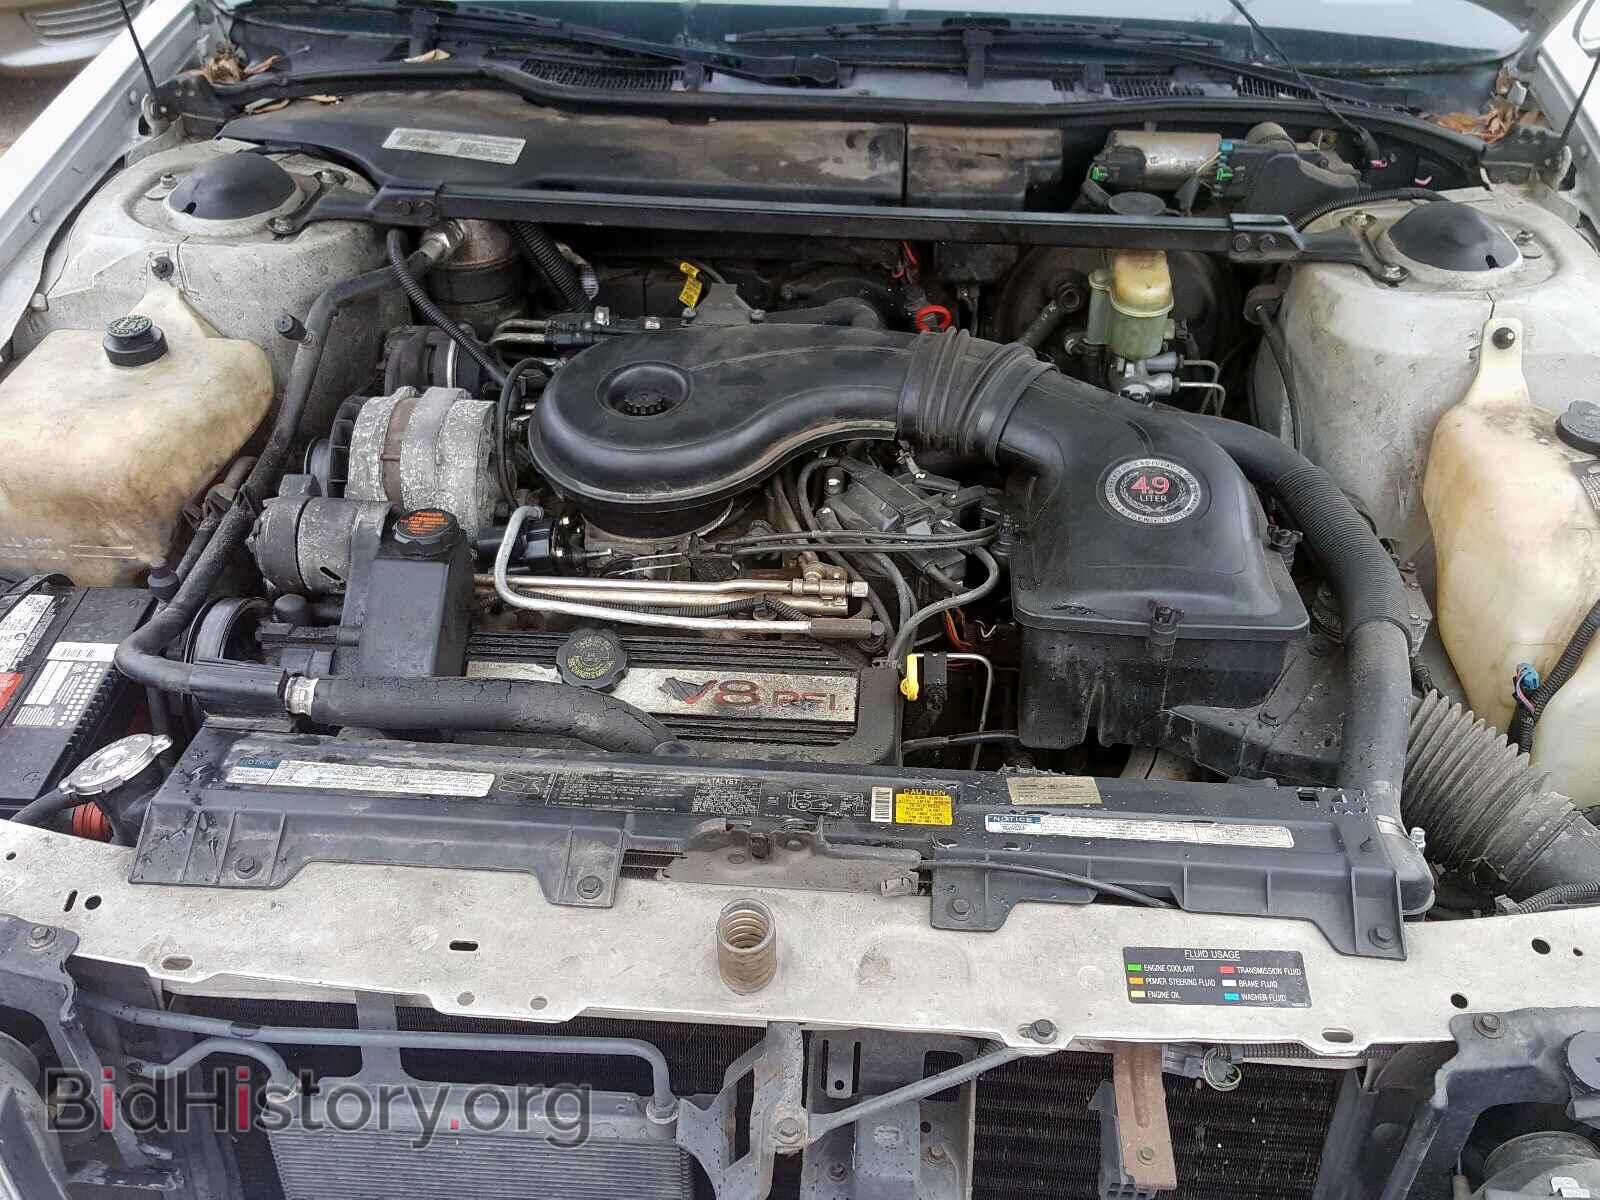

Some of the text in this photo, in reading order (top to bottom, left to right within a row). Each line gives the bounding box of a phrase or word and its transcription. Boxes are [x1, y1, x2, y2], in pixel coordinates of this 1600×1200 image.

[1129, 475, 1170, 495] 4.9
[903, 788, 946, 796] CAUTION
[992, 815, 1034, 823] NOTICE
[1184, 950, 1241, 959] FLUID USAGE
[1143, 964, 1195, 973] ENGINE COOLANT
[1236, 966, 1301, 976] TRANSMISSION FLUID
[1145, 978, 1167, 986] POWER
[1238, 980, 1278, 989] BRAKE FLUID
[1147, 991, 1170, 999] ENGINE
[1241, 993, 1287, 1002] WASHER FLUID
